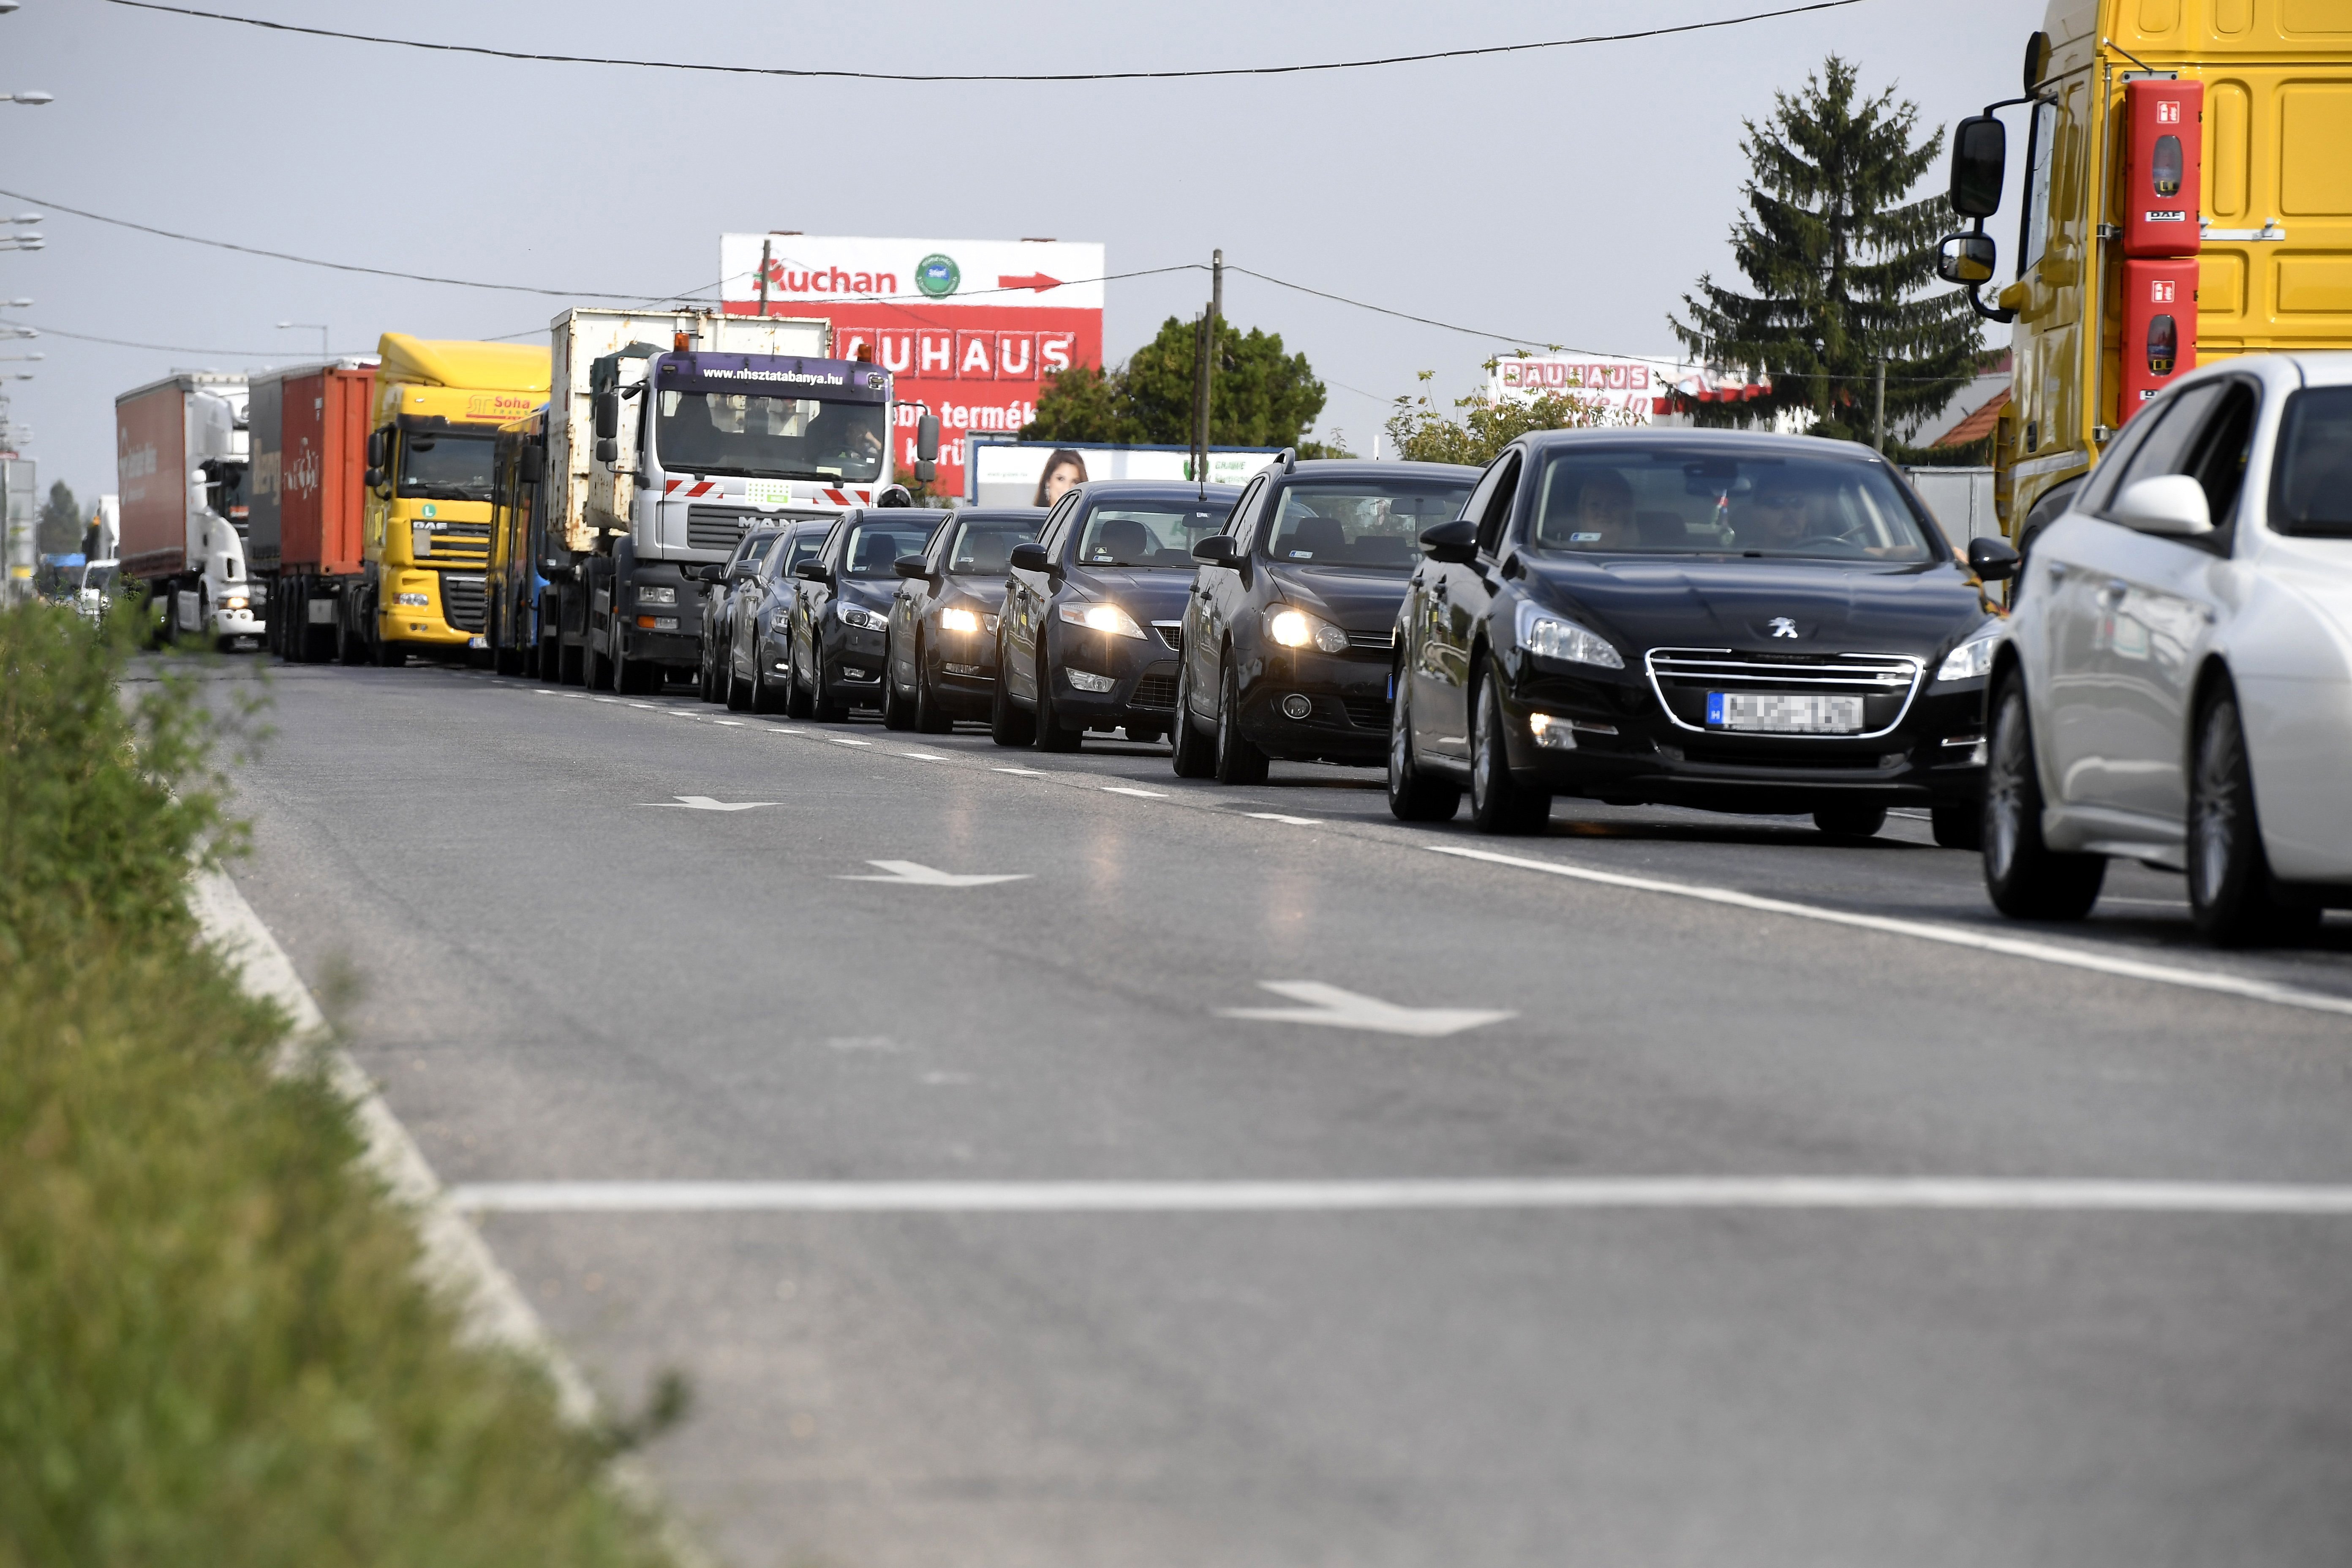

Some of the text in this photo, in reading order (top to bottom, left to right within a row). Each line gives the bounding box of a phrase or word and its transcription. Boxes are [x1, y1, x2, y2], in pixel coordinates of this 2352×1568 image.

[753, 259, 896, 294] Auchan
[845, 335, 1070, 373] AUHAUS
[703, 368, 843, 386] www.nhsztatabanya.hu
[1505, 364, 1647, 387] BAUHAUS
[495, 396, 530, 409] Soha
[425, 506, 433, 516] L
[413, 521, 448, 530] DAF
[738, 517, 796, 528] MAN
[1711, 711, 1720, 719] H
